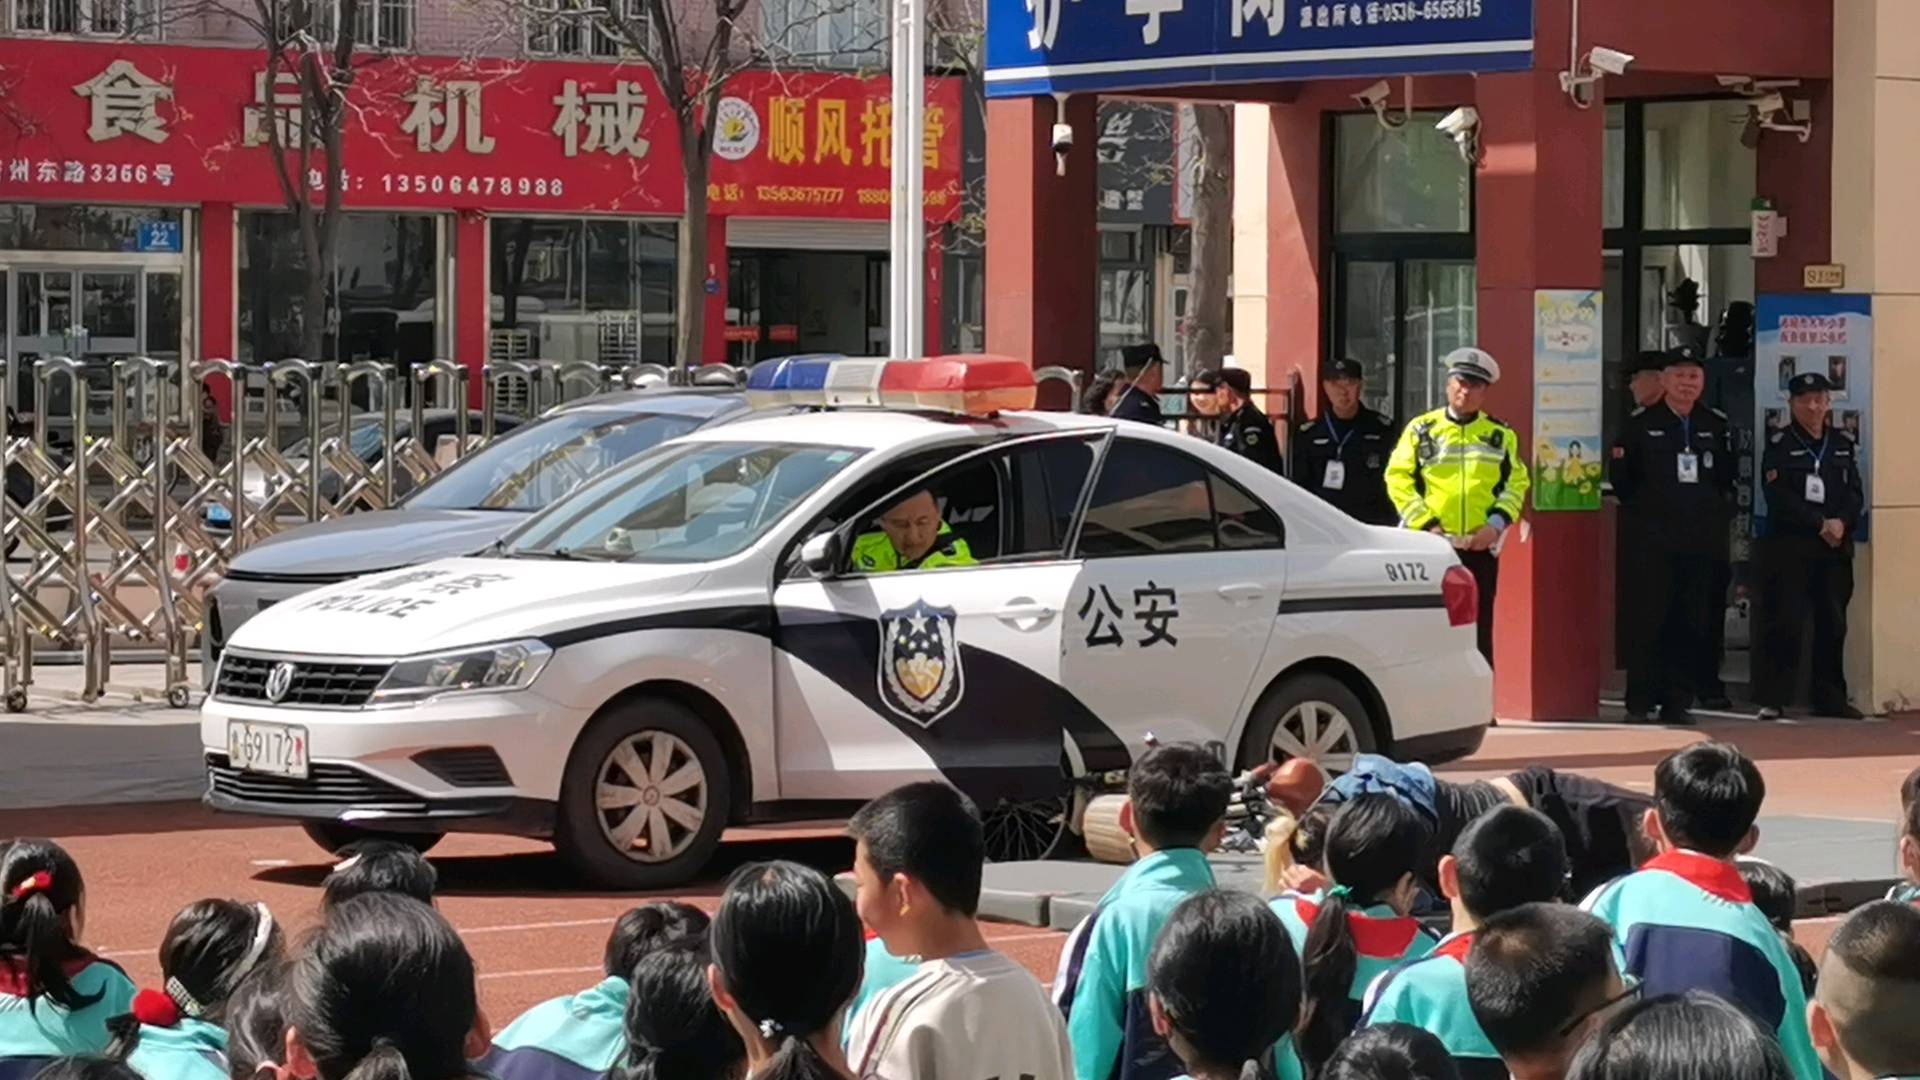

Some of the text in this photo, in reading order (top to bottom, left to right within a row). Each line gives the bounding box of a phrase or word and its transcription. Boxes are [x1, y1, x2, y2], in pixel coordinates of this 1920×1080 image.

[767, 96, 945, 169] 顺风托管
[0, 158, 175, 186] 州东路3366号
[382, 174, 563, 196] 13506478988
[1384, 562, 1430, 582] 9172
[1078, 580, 1180, 648] 公安
